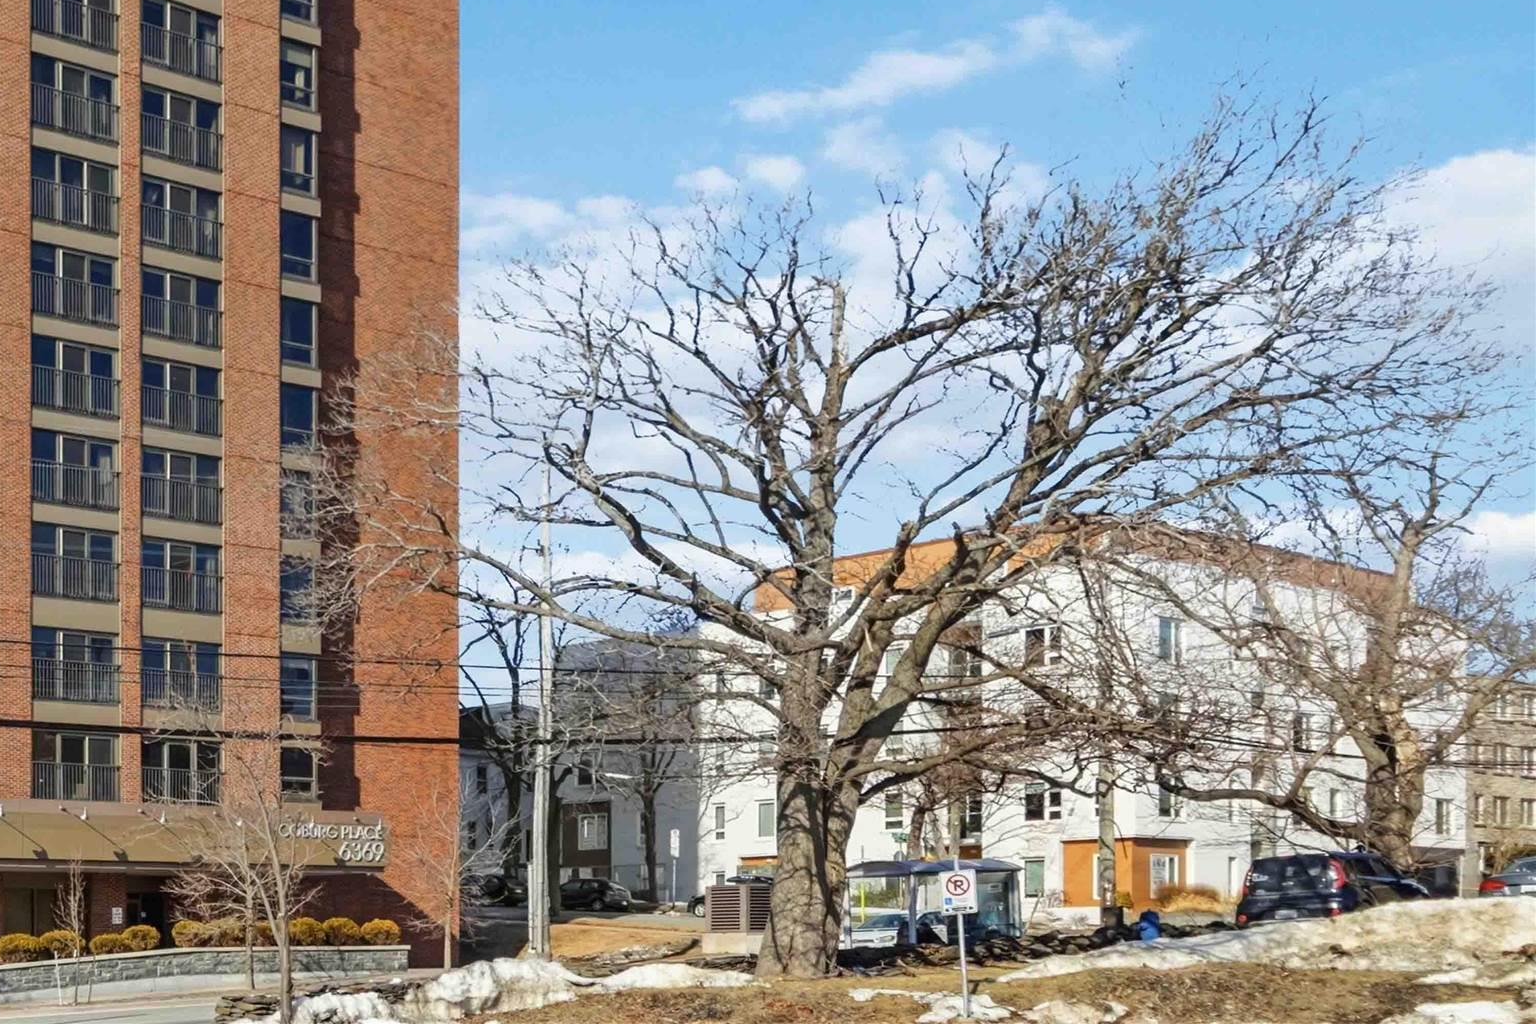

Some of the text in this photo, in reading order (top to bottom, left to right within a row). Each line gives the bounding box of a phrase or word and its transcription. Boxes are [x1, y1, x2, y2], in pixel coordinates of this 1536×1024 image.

[279, 823, 384, 840] COBURG PLACE
[339, 841, 385, 862] 6369
